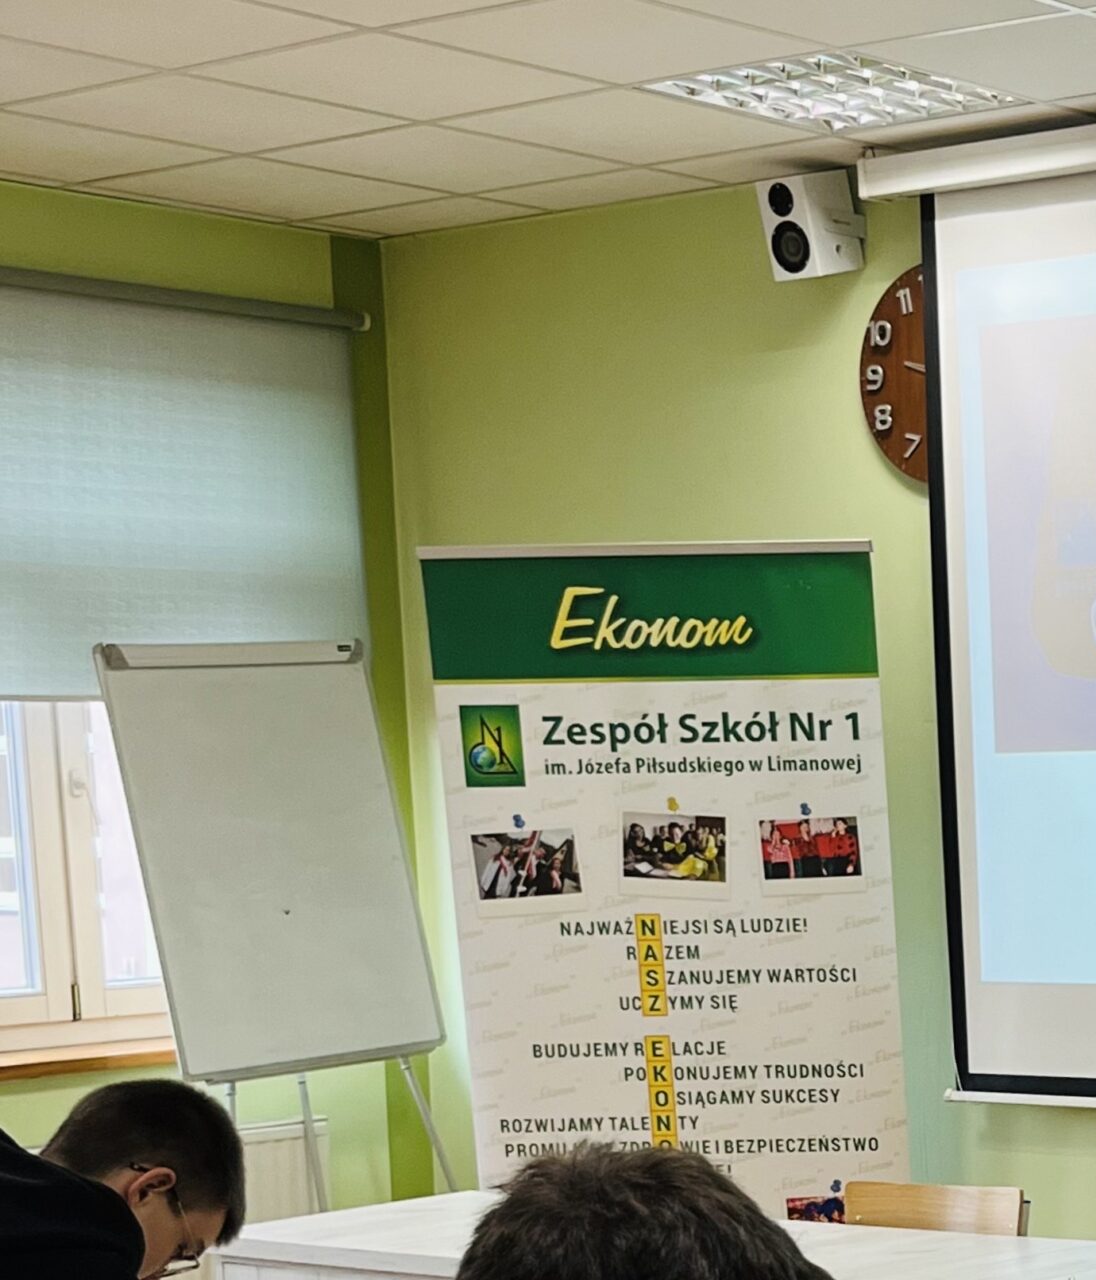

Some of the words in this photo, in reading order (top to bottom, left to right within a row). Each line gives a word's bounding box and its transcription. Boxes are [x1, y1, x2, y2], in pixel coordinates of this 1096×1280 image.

[896, 287, 913, 315] 11
[868, 320, 892, 346] 10
[866, 365, 884, 391] 9
[874, 404, 892, 430] 8
[904, 433, 922, 458] 7
[551, 586, 753, 650] Ekonom
[541, 712, 669, 752] Zespół
[678, 711, 780, 744] Szkół
[788, 712, 833, 742] Nr
[845, 712, 861, 741] 1
[544, 758, 574, 775] im.
[576, 755, 632, 776] Józefa
[636, 756, 745, 777] Piłsudskiego
[748, 759, 764, 773] w
[767, 754, 863, 775] Limanowej
[713, 918, 738, 938] SĄ
[740, 917, 808, 934] LUDZIE!
[766, 964, 858, 984] WARTOŚCI
[710, 994, 739, 1013] SIĘ
[532, 1041, 629, 1059] BUDUJEMY
[763, 1060, 865, 1079] TRUDNOŚCI
[760, 1088, 841, 1105] SUKCESY
[500, 1116, 604, 1133] ROZWIJAMY
[724, 1134, 880, 1154] BEZPIECZEŃSTWO
